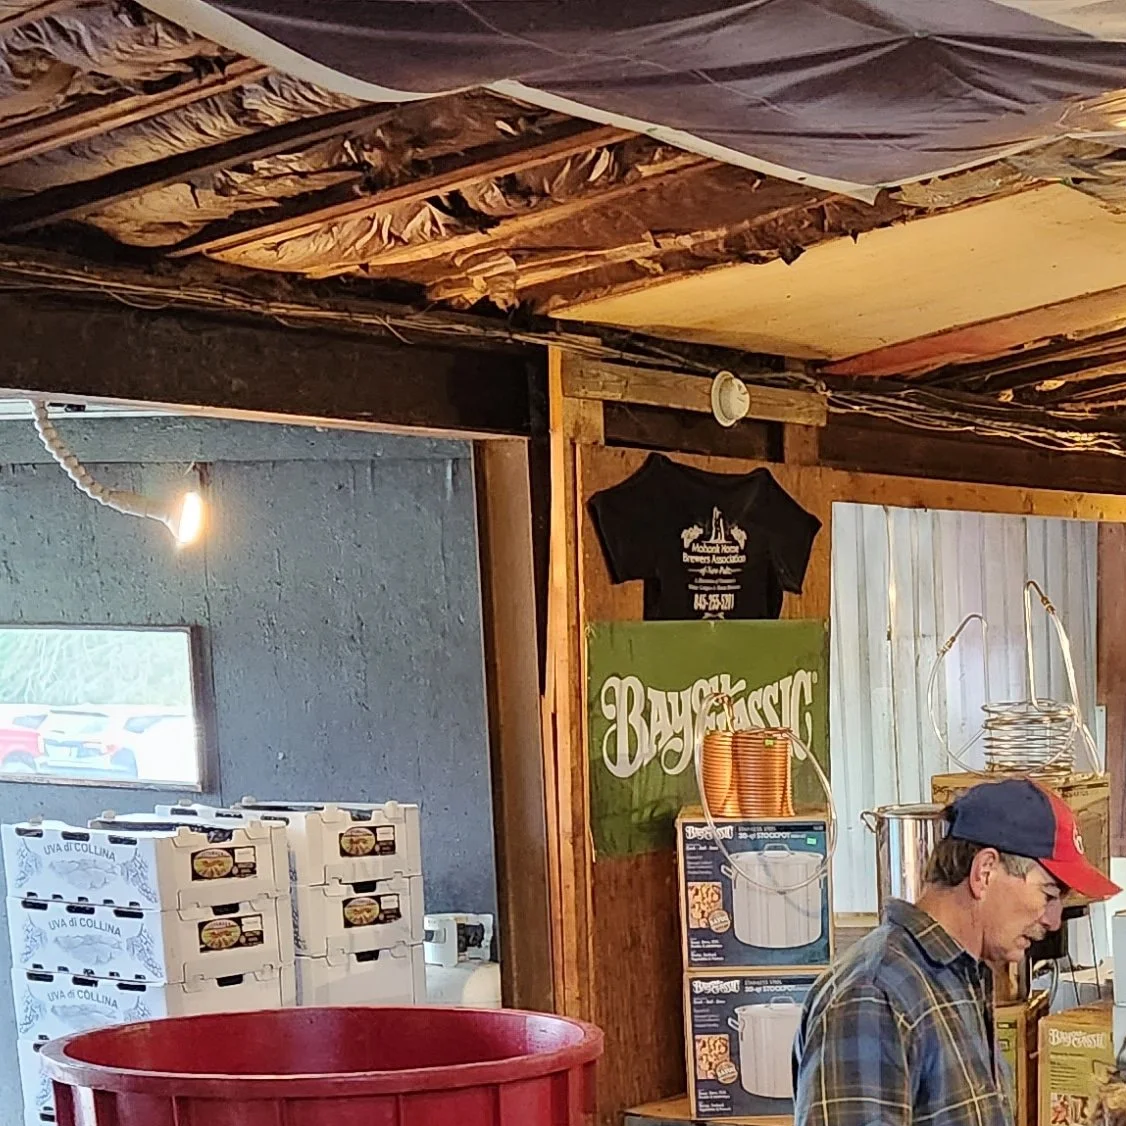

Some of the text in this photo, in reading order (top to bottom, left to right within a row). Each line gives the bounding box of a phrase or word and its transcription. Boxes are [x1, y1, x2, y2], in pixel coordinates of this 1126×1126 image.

[683, 552, 747, 564] Brewers Association
[44, 843, 62, 856] UVA
[74, 842, 116, 862] COLLINA
[48, 918, 122, 938] UVA di COLLINA
[47, 990, 66, 1002] UVA
[77, 989, 118, 1009] COLLINA
